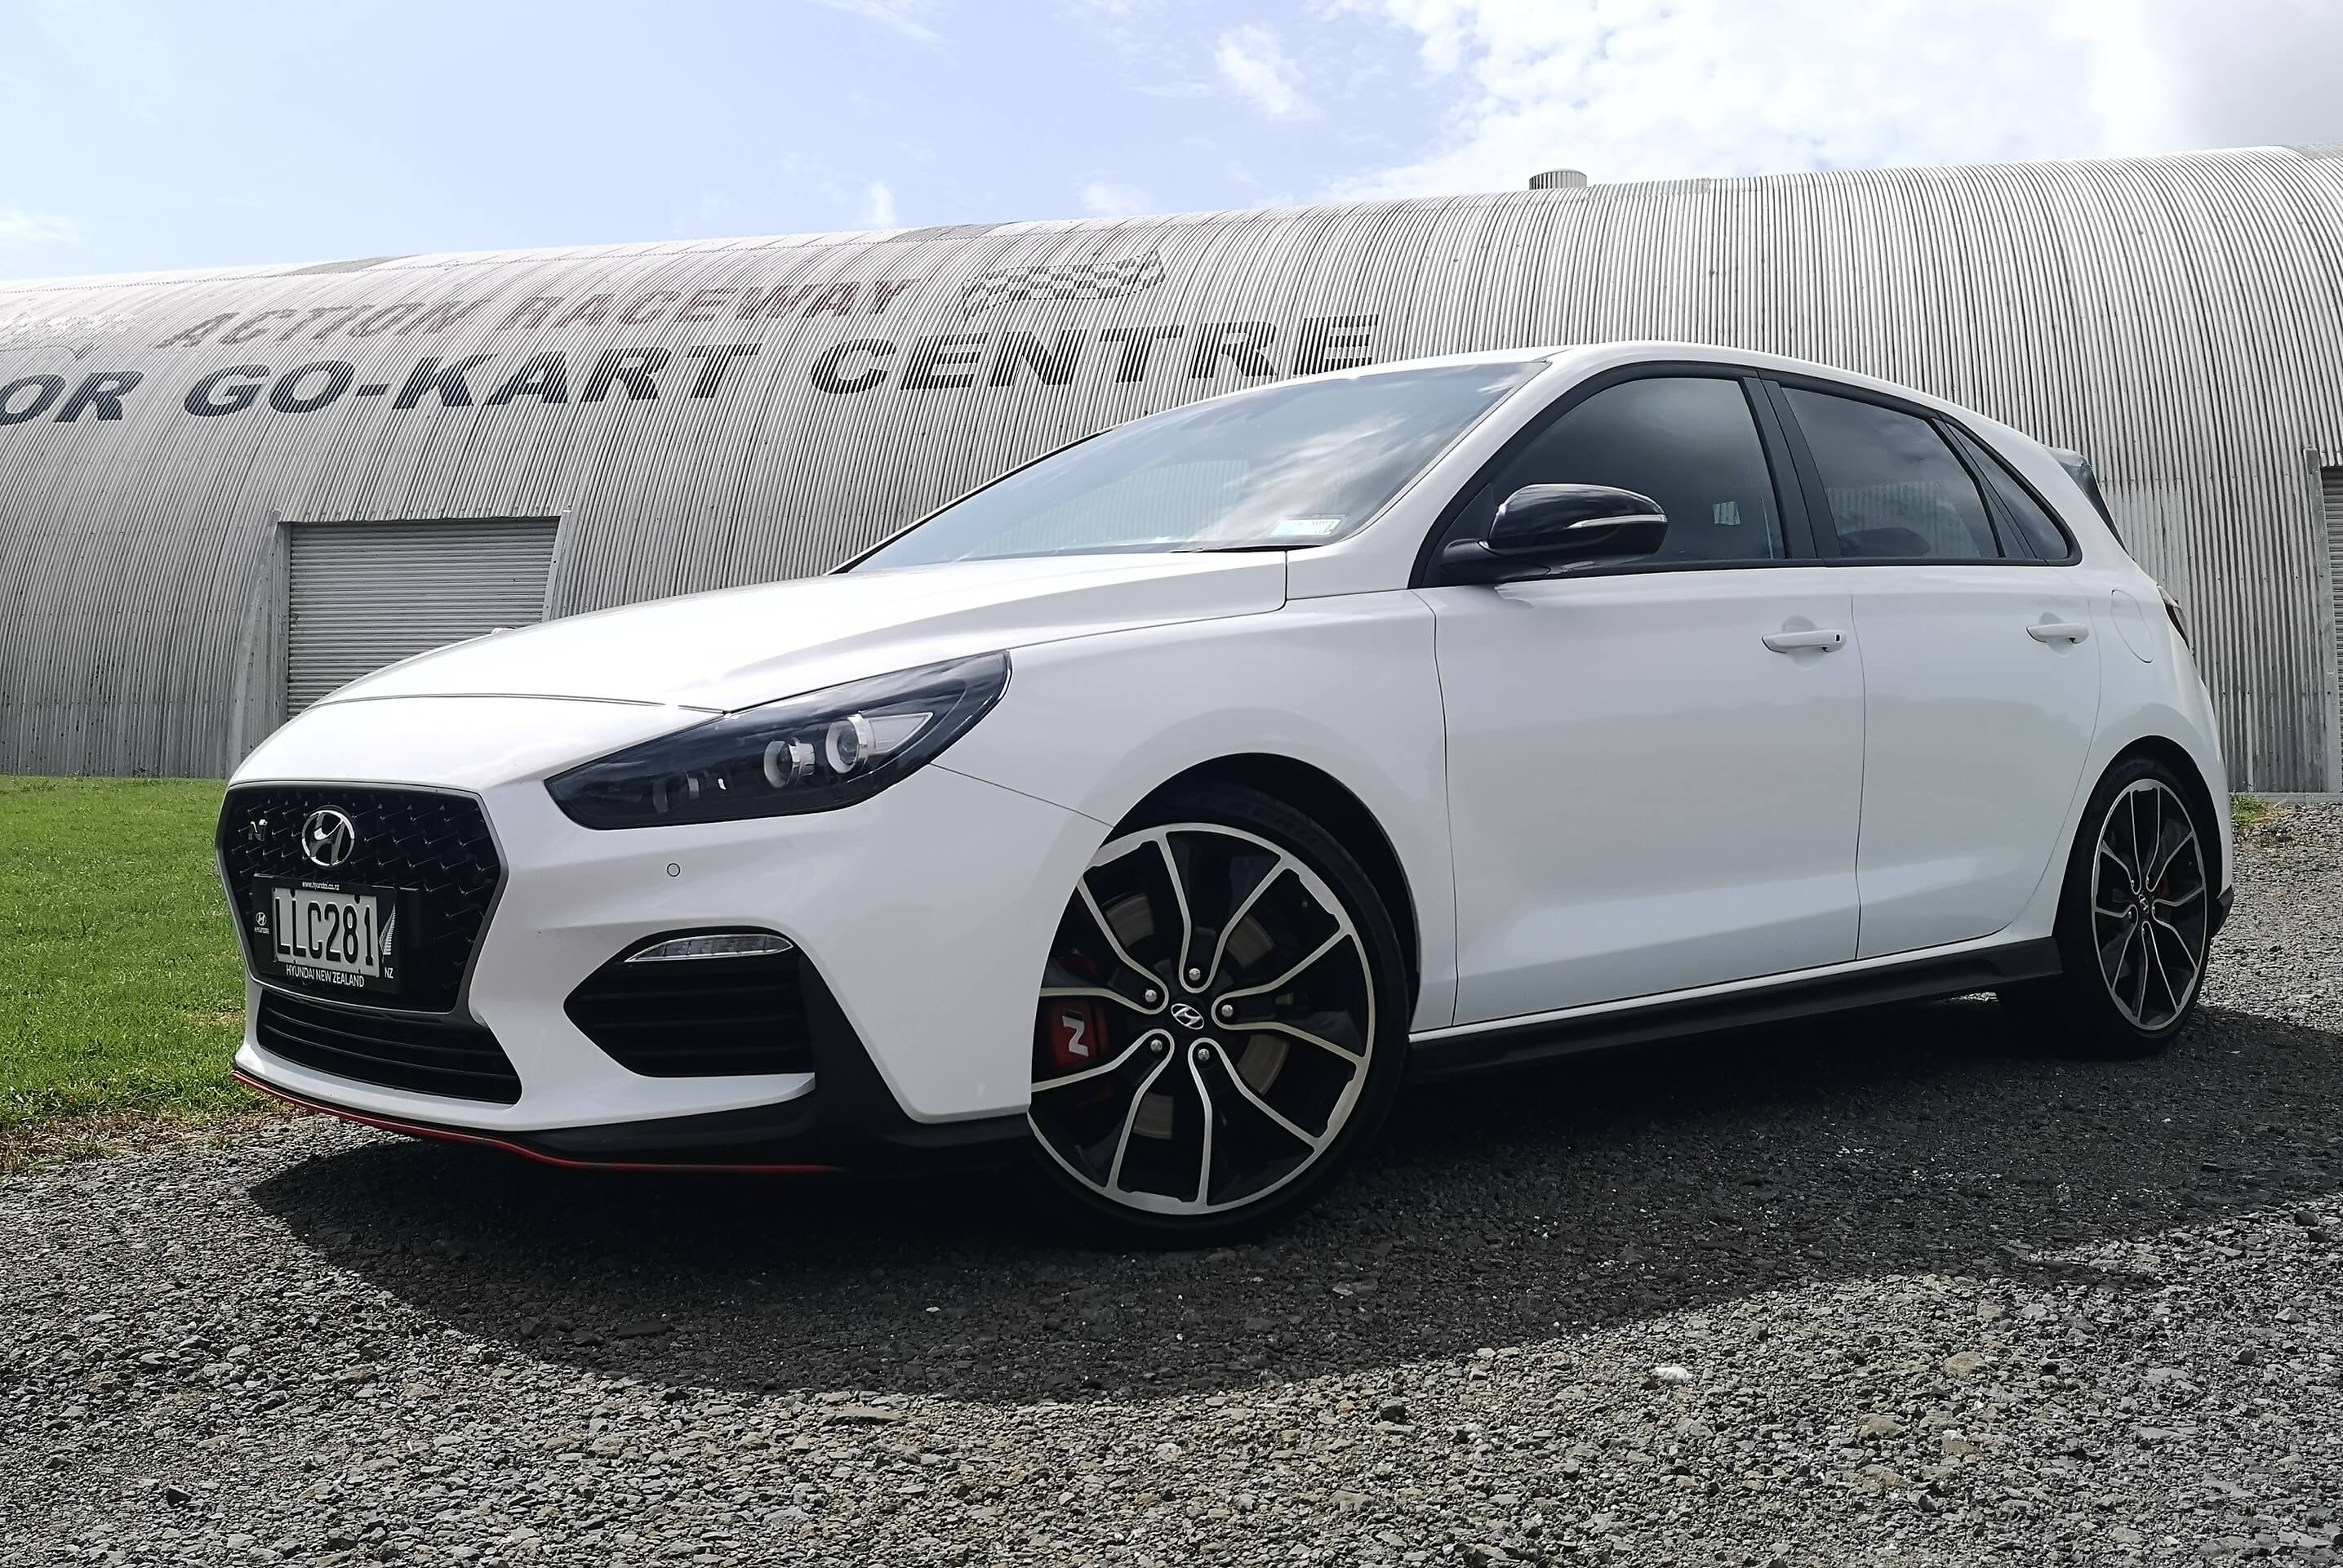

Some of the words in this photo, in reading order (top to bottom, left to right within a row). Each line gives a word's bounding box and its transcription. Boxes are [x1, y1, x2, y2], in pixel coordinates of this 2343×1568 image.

[153, 300, 495, 349] ACTION
[505, 278, 919, 329] RACEWAY
[184, 343, 763, 417] GO-KART
[810, 313, 1380, 395] CENTRE
[275, 897, 374, 966] LLC281
[286, 964, 315, 980] HYUNDAI
[316, 969, 331, 983] NEW
[332, 971, 365, 988] ZEALAND
[385, 966, 393, 979] NZ
